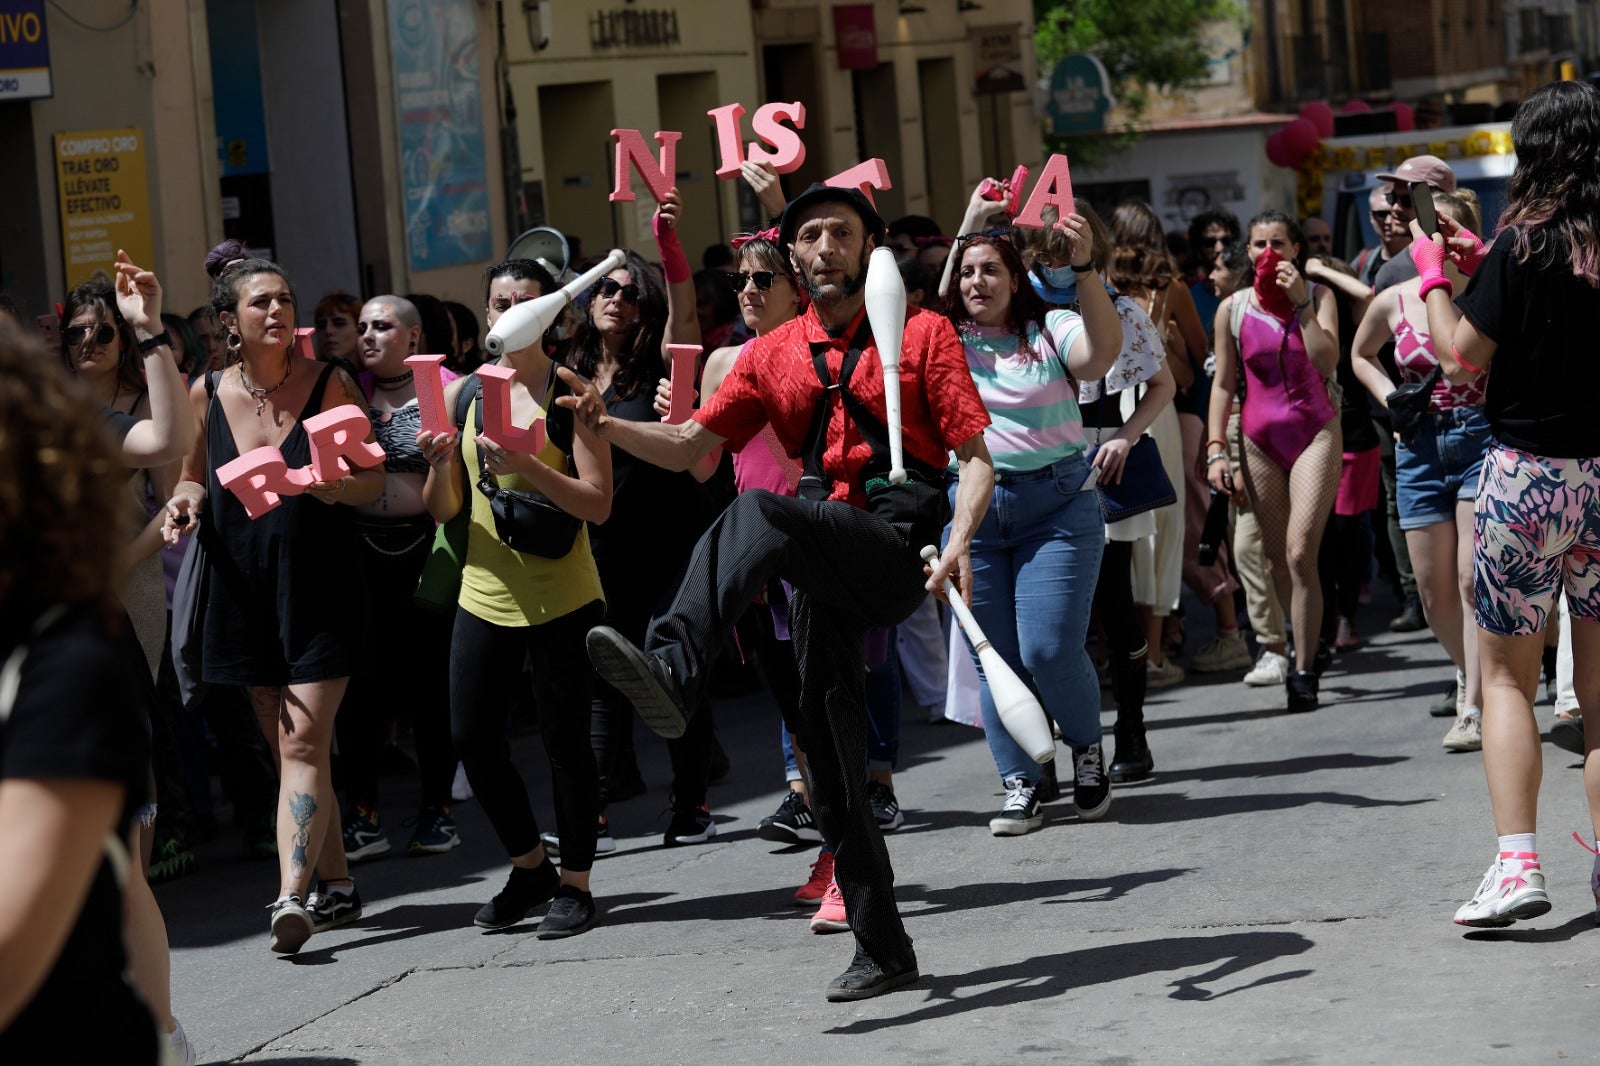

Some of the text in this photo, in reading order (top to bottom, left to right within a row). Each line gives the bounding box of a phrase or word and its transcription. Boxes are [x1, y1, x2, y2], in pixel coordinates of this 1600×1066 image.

[60, 135, 137, 157] COMPRO ORO
[62, 157, 119, 176] TRAE ORO
[65, 177, 111, 196] LLÉVATE
[67, 196, 121, 214] EFECTIVO
